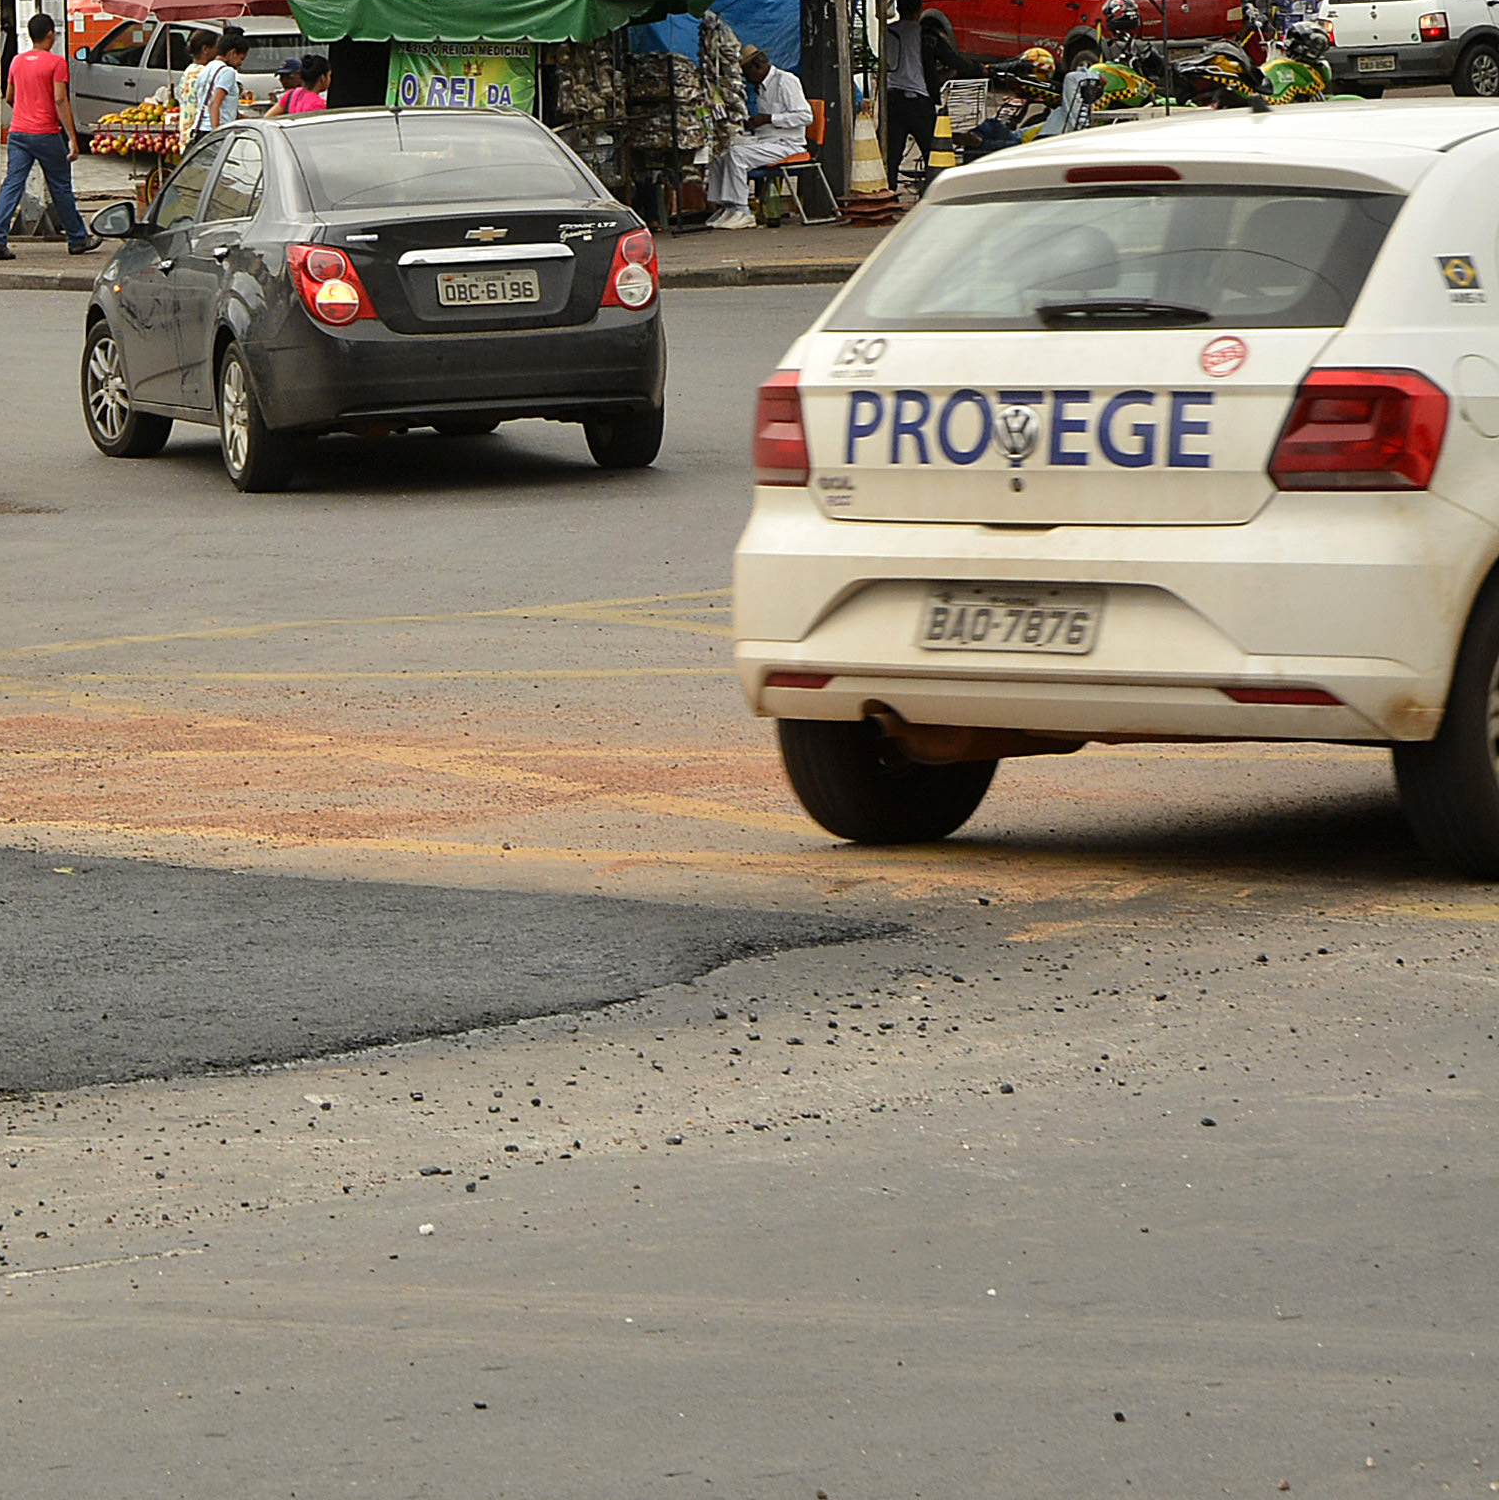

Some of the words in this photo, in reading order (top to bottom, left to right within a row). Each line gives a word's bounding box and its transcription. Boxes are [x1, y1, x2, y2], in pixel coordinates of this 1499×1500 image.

[432, 44, 440, 56] O
[442, 44, 459, 55] REI
[461, 44, 476, 55] DA
[479, 44, 530, 57] MEDICINA
[400, 72, 418, 106] O
[427, 75, 476, 107] REI
[487, 84, 512, 106] DA
